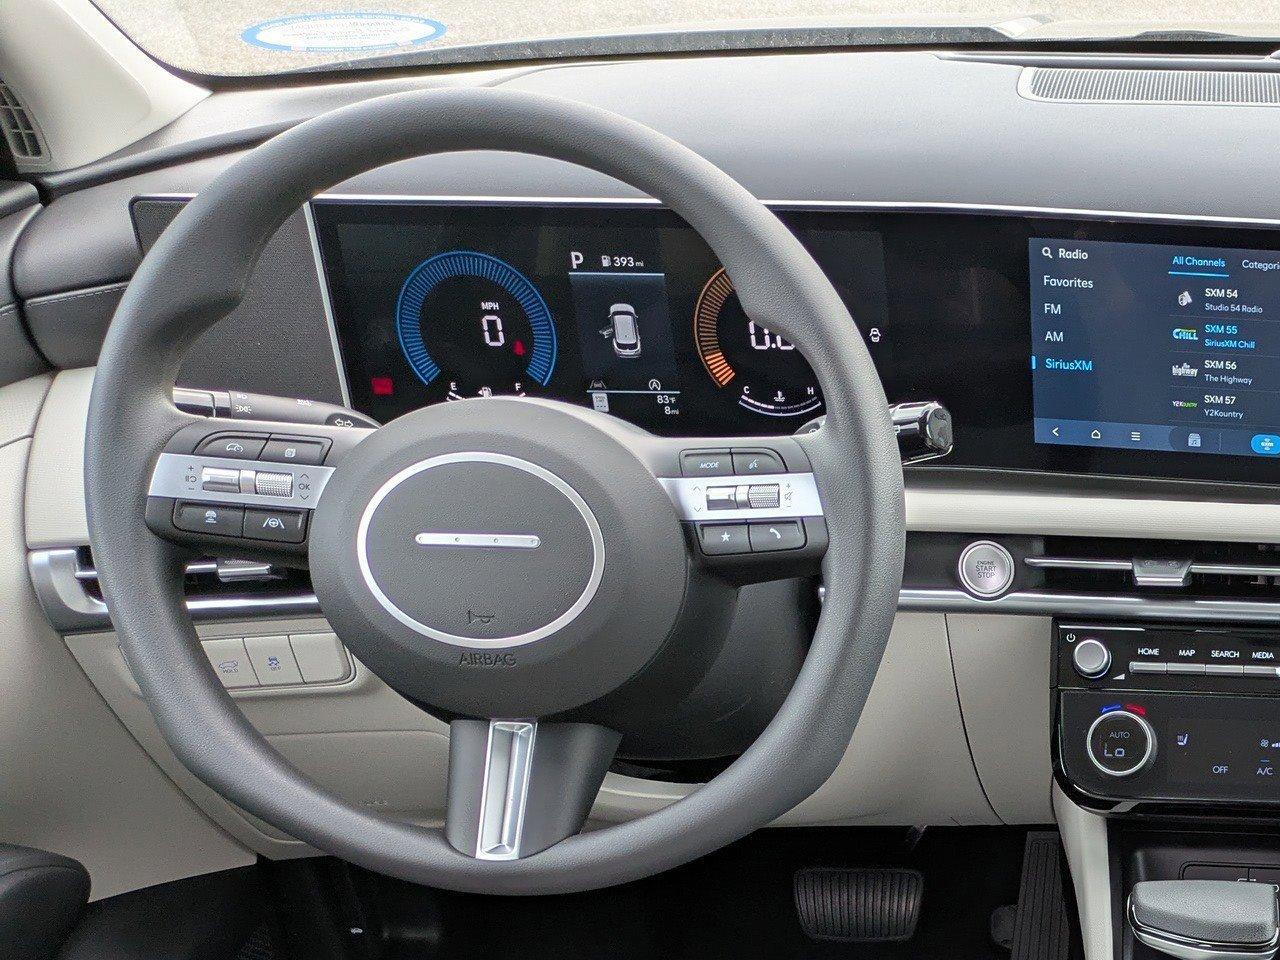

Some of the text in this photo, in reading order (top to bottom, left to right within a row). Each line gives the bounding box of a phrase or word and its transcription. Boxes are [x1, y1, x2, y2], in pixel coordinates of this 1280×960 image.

[1058, 248, 1088, 260] Radio
[570, 252, 584, 268] P
[614, 257, 634, 267] 393
[1172, 256, 1226, 268] All Channels
[1044, 276, 1094, 290] Favorites
[1205, 288, 1238, 298] SXM 54
[481, 302, 499, 310] MPH
[1044, 304, 1062, 315] FM
[1205, 303, 1263, 314] Studio 54 Radio
[481, 314, 505, 346] 0
[1172, 328, 1198, 340] CHILL
[1204, 324, 1224, 334] SXM
[1226, 326, 1238, 334] 55
[1045, 331, 1064, 342] AM
[1204, 338, 1256, 349] SiriusXM Chill
[1046, 358, 1093, 372] SiriusXM
[1204, 360, 1237, 370] SXM 56
[1204, 374, 1252, 386] The Highway
[450, 382, 456, 390] E
[515, 382, 522, 390] F
[744, 386, 750, 394] C
[807, 386, 814, 395] H
[1204, 395, 1236, 405] SXM 57
[1204, 409, 1244, 420] Y2Kountry
[298, 483, 310, 491] OK
[459, 653, 517, 667] AIRBAG
[1252, 652, 1274, 660] MEDIA
[1109, 731, 1130, 739] AUTO
[1212, 766, 1228, 774] OFF
[1256, 767, 1273, 776] A/C
